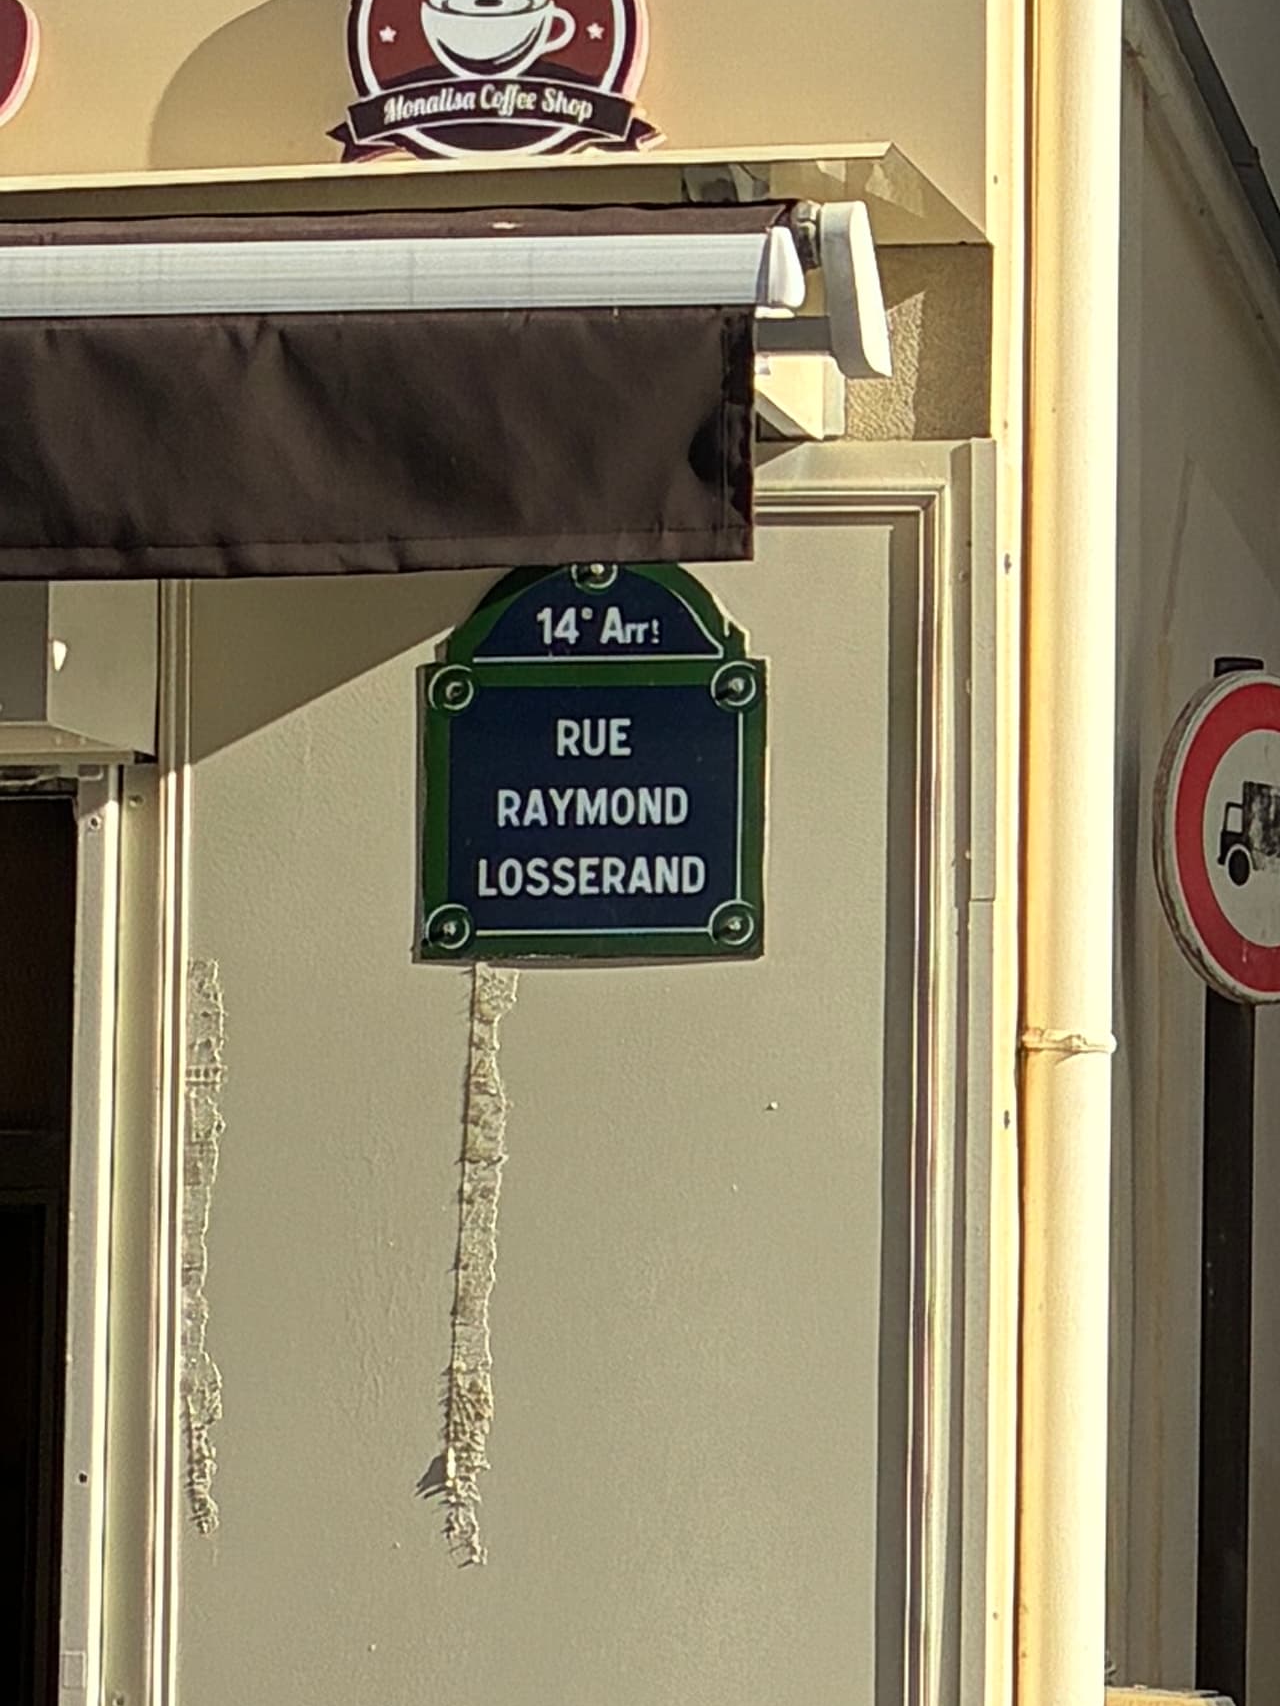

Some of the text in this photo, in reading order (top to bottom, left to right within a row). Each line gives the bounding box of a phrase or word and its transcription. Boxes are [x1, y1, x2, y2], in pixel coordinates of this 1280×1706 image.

[384, 84, 593, 125] Monalisa Coffee Shop
[556, 718, 632, 756] RUE
[497, 786, 689, 827] RAYMOND
[478, 856, 706, 898] LOSSERAND
